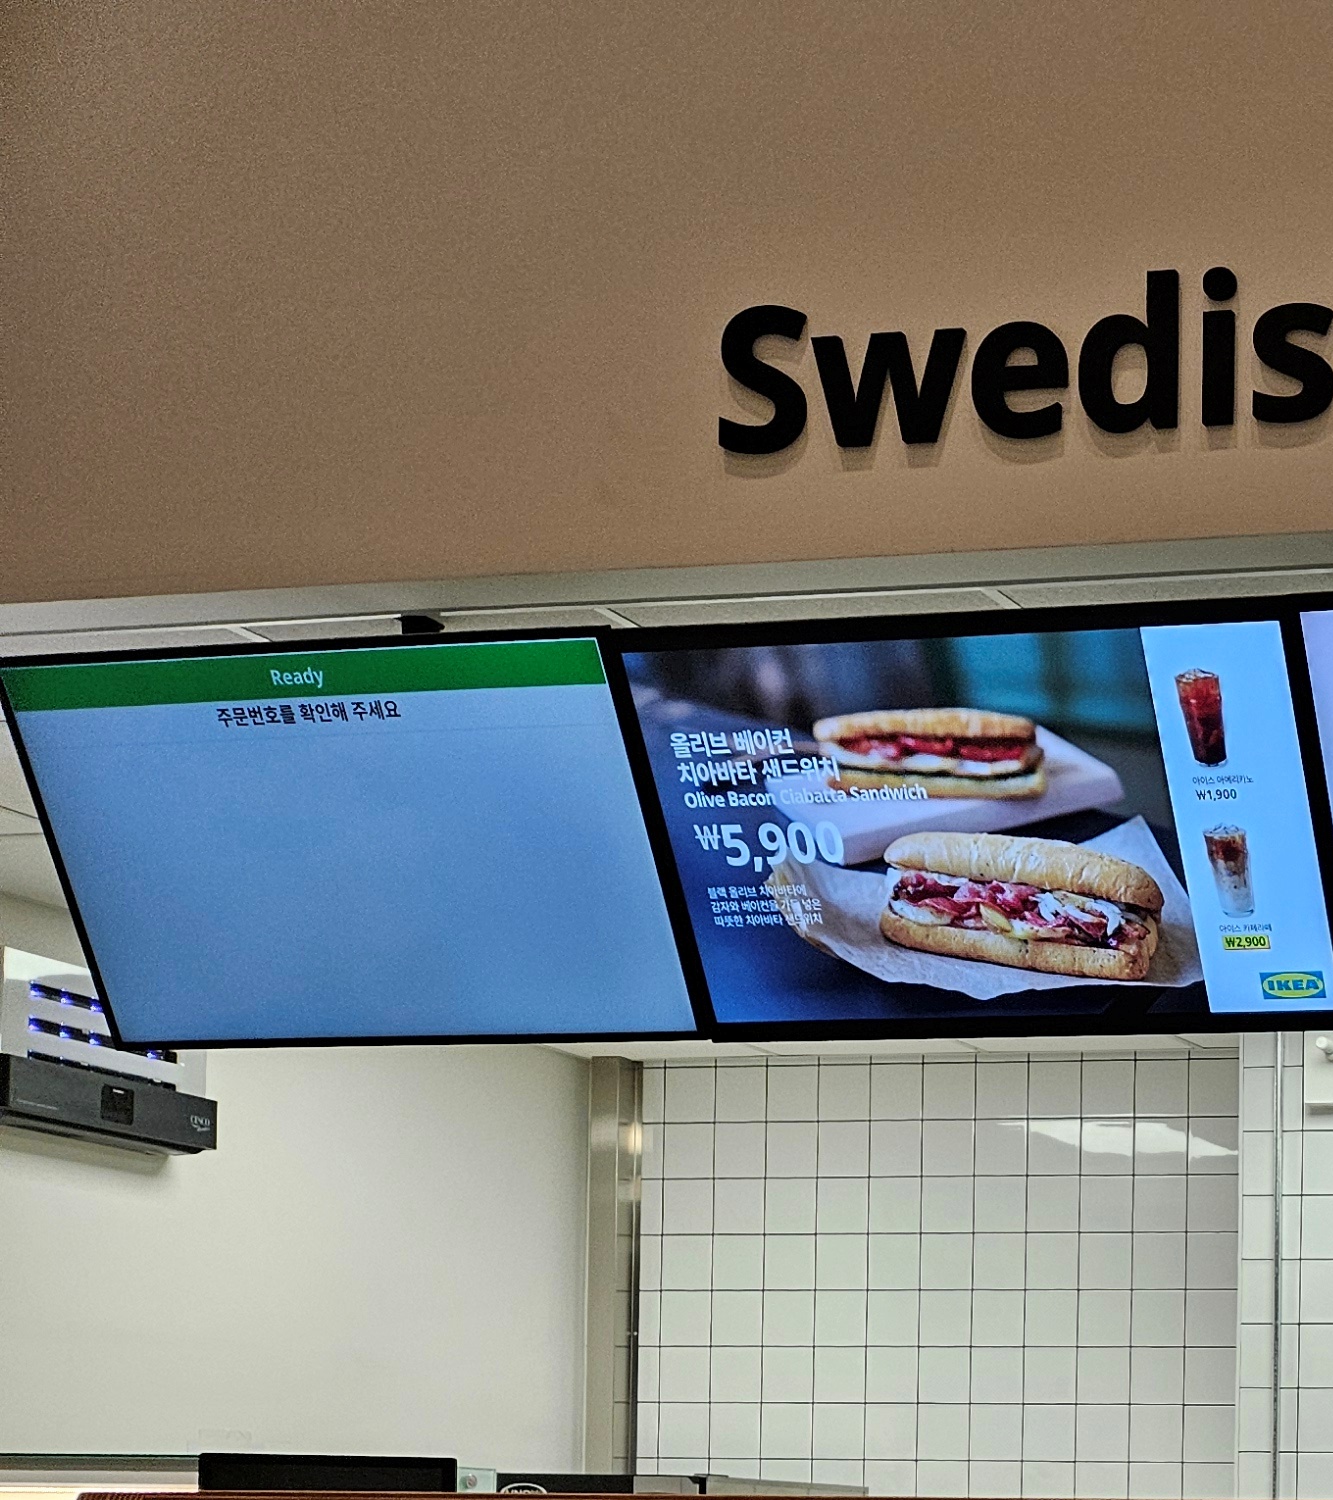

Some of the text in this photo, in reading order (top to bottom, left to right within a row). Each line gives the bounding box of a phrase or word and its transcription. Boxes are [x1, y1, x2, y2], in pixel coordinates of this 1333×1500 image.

[270, 667, 324, 688] Ready
[216, 700, 401, 728] 주문번호를 확인해 주세요
[670, 728, 795, 759] 올리브 베이컨
[677, 756, 841, 787] 치아바타 샌드위치
[684, 783, 928, 809] Olive Bacon Ciabatta Sandwich
[1195, 789, 1237, 801] ₩1,900
[693, 821, 844, 872] ₩5,900
[728, 885, 757, 899] 올리브
[714, 915, 744, 927] 따뜻한
[745, 914, 784, 926] 치아바타
[1224, 936, 1266, 948] ₩2,900
[1267, 979, 1320, 991] IKEA
